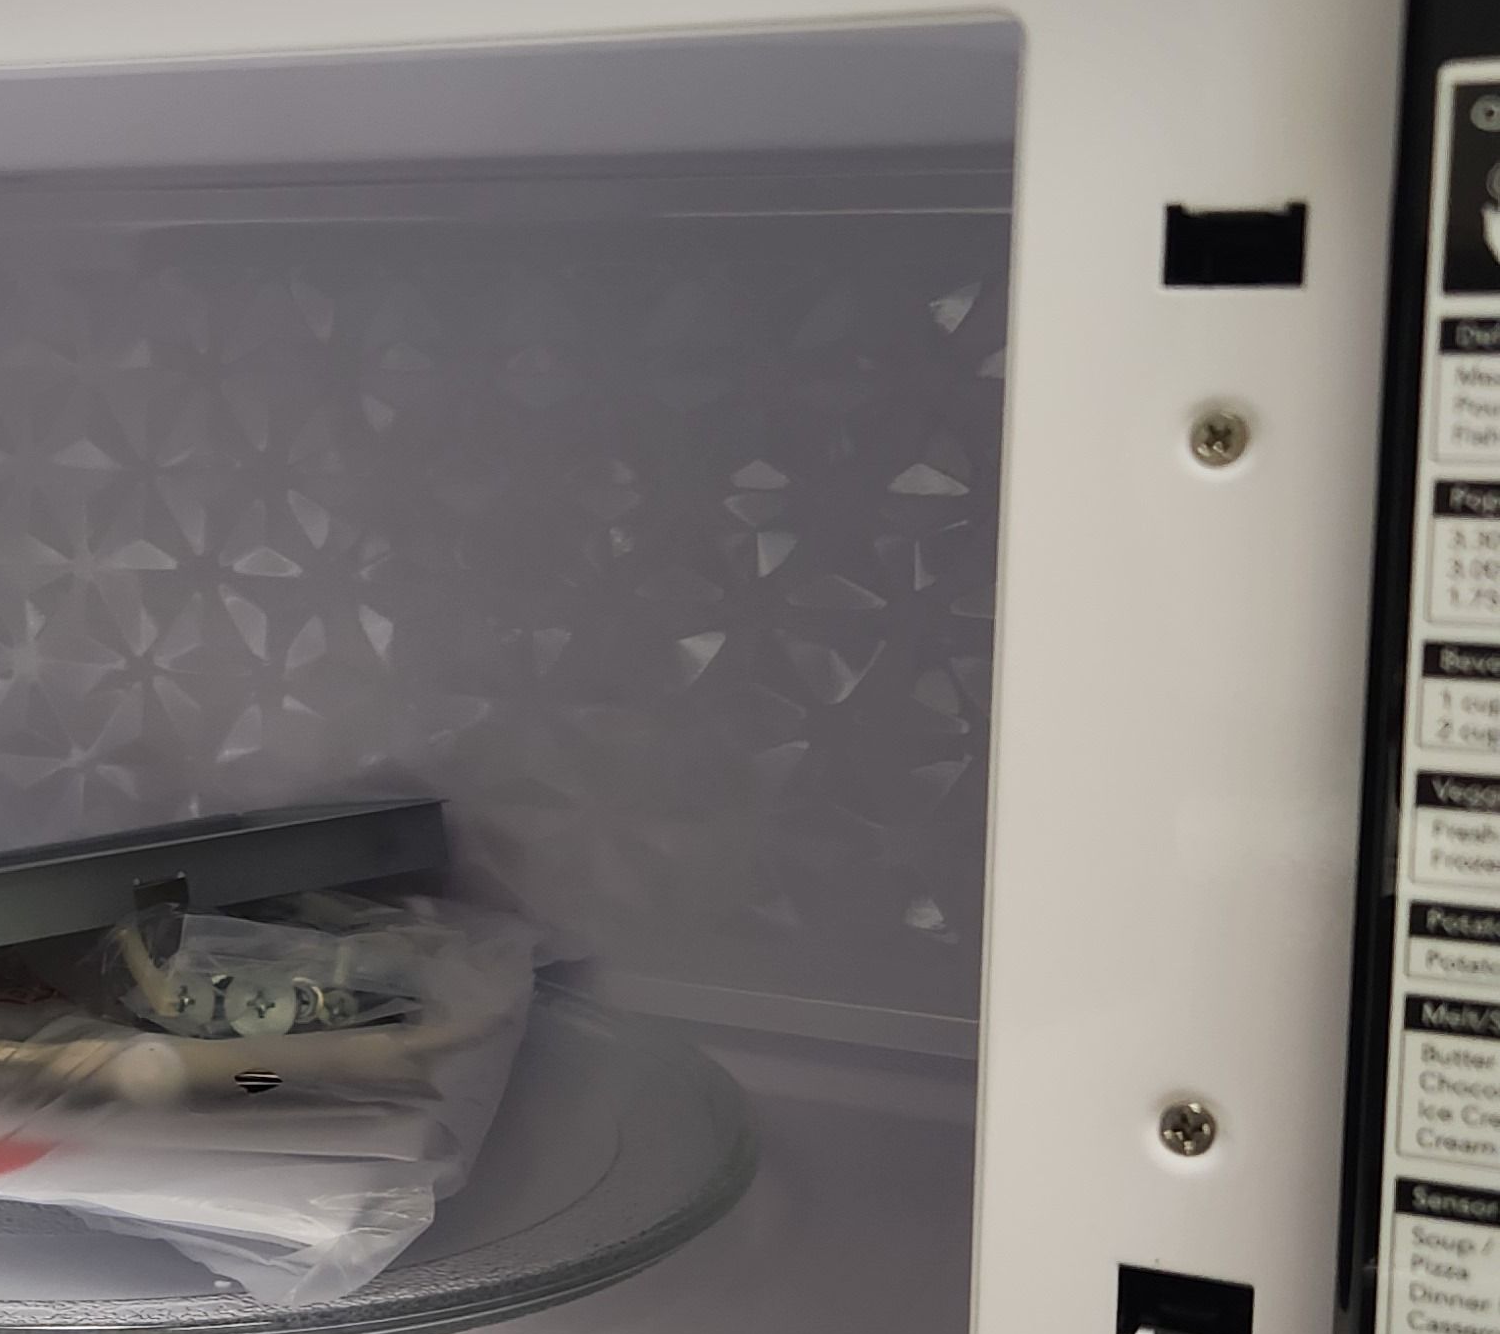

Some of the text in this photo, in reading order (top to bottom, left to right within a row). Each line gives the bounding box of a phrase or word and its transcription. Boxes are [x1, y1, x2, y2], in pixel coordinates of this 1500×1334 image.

[1412, 1185, 1499, 1216] Sensor
[1411, 1226, 1476, 1258] Soup
[1411, 1253, 1471, 1282] Pizza
[1409, 1279, 1490, 1312] Dinner
